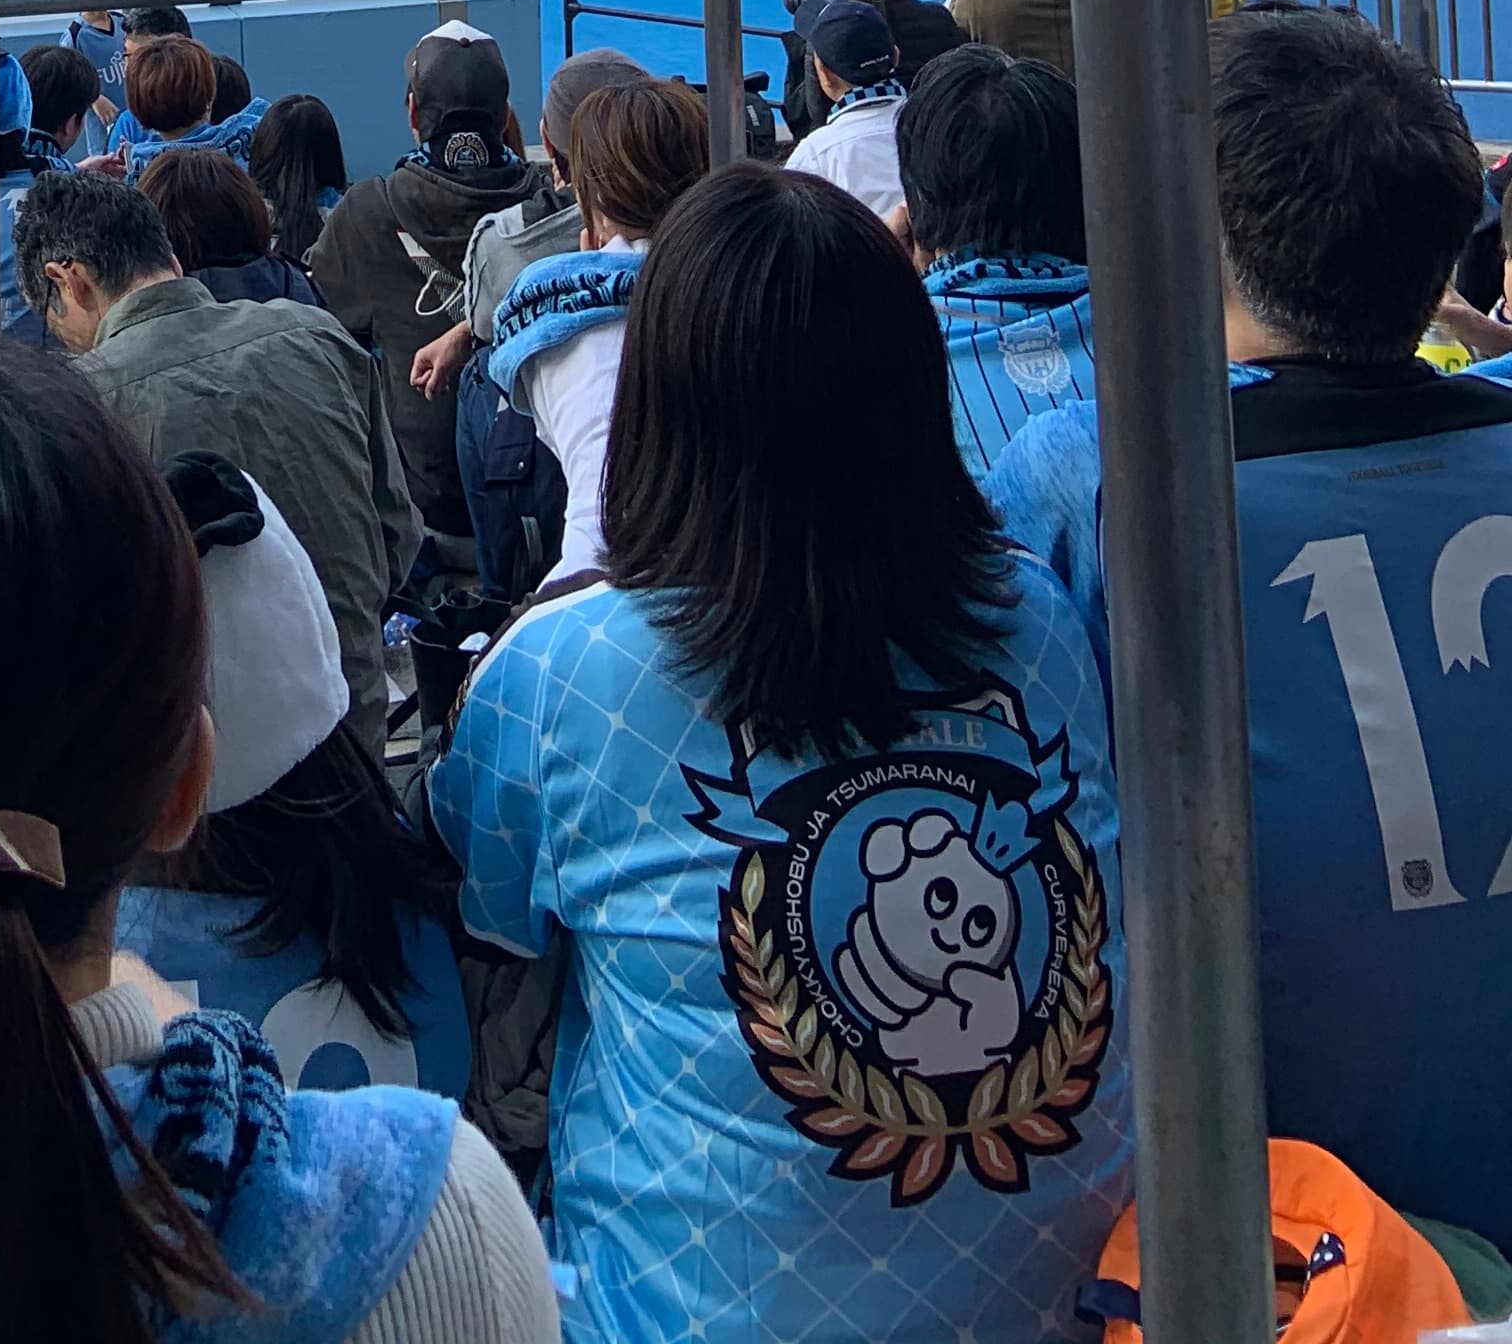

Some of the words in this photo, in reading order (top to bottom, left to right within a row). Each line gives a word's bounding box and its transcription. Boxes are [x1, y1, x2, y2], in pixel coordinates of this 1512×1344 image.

[806, 808, 831, 841] JA
[825, 762, 977, 809] TSUMARANAI
[785, 843, 864, 1050] CHOKKYUSHOBU
[1034, 862, 1068, 1021] CURVERERA
